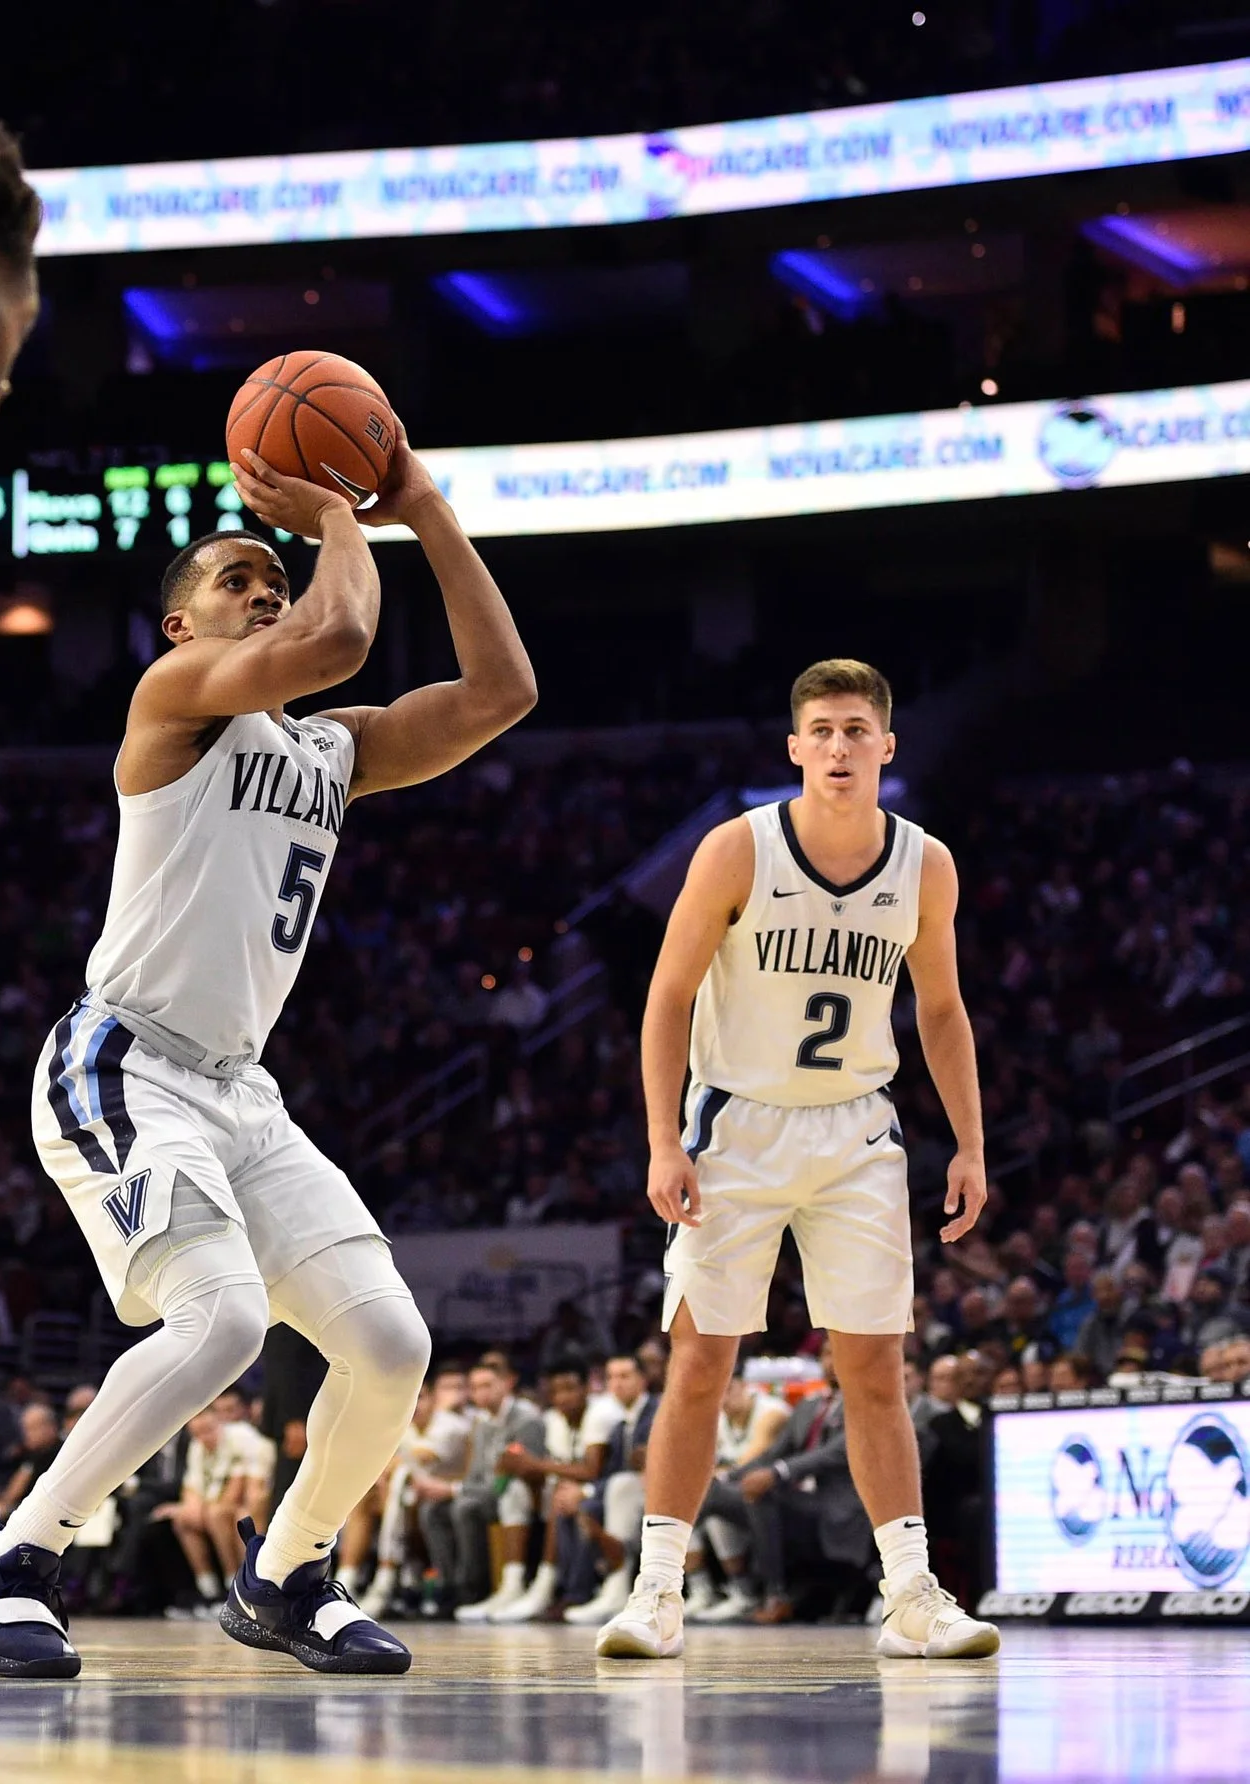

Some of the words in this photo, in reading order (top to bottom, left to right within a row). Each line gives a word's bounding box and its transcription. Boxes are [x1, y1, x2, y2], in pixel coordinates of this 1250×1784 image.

[271, 842, 327, 954] 5
[795, 992, 851, 1071] 2
[101, 1168, 152, 1246] V
[976, 1591, 1058, 1616] GEICO
[1063, 1591, 1150, 1616] GEICO
[1160, 1591, 1249, 1616] GEICO
